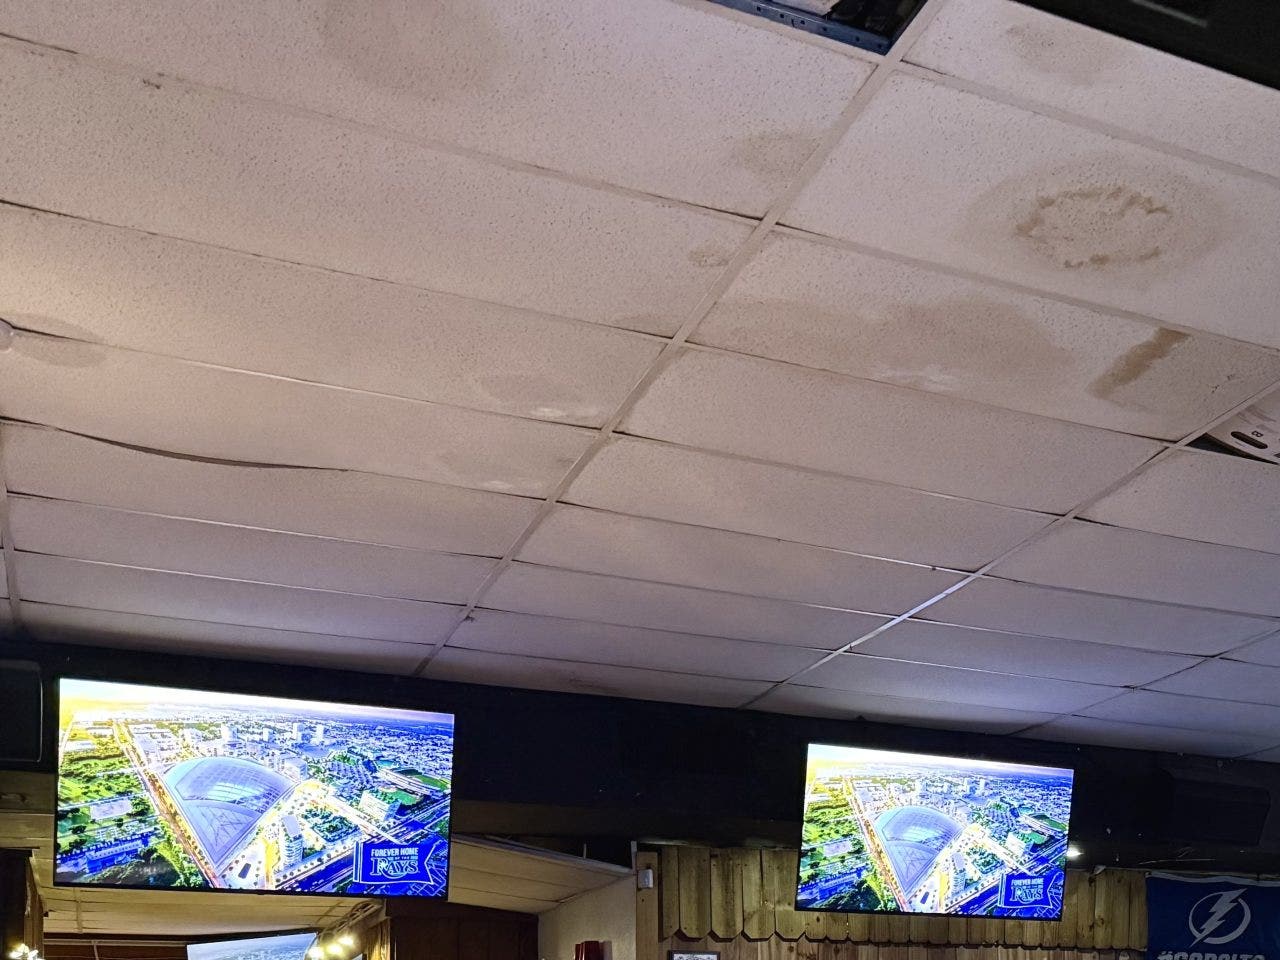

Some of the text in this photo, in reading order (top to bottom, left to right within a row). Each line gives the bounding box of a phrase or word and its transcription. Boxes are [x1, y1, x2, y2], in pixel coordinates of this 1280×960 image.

[371, 847, 419, 857] FOREVER HOME
[370, 858, 419, 879] RAYS
